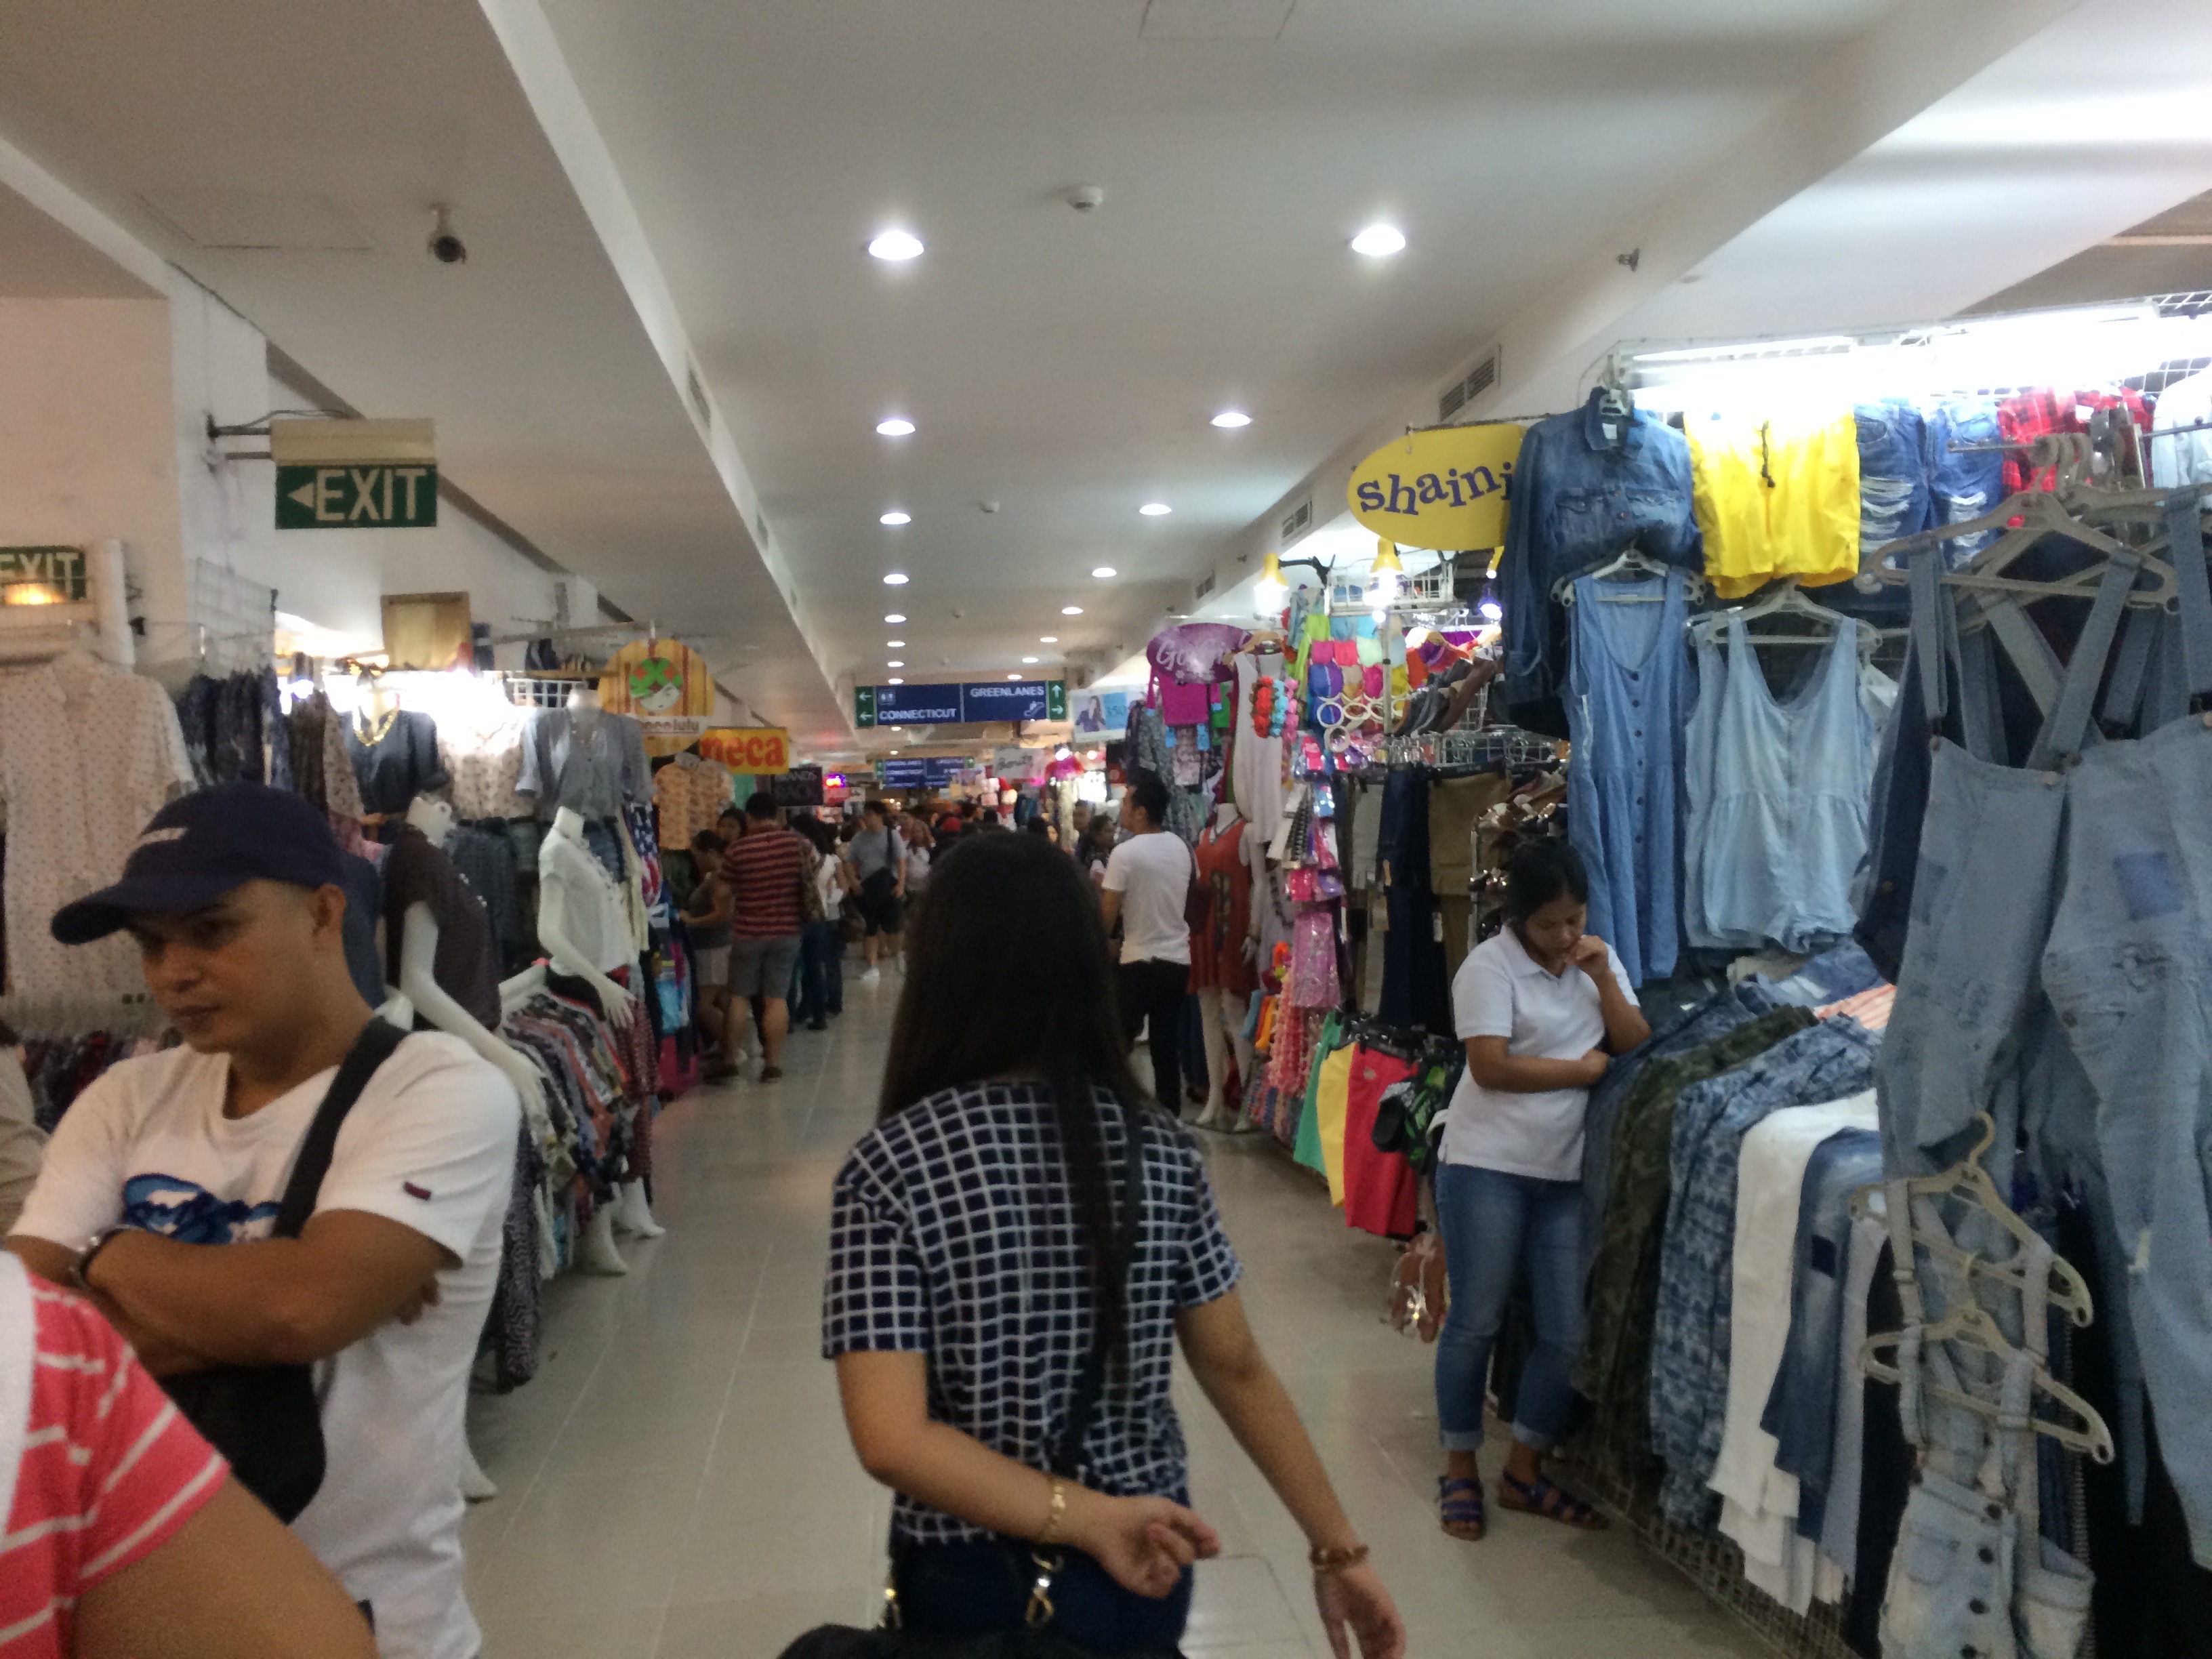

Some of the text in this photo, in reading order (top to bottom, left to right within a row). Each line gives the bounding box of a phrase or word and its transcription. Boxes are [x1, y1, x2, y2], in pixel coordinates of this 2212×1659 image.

[316, 468, 426, 520] EXIT
[970, 686, 1045, 697] GREENLANES
[879, 708, 957, 720] CONNECTICUT
